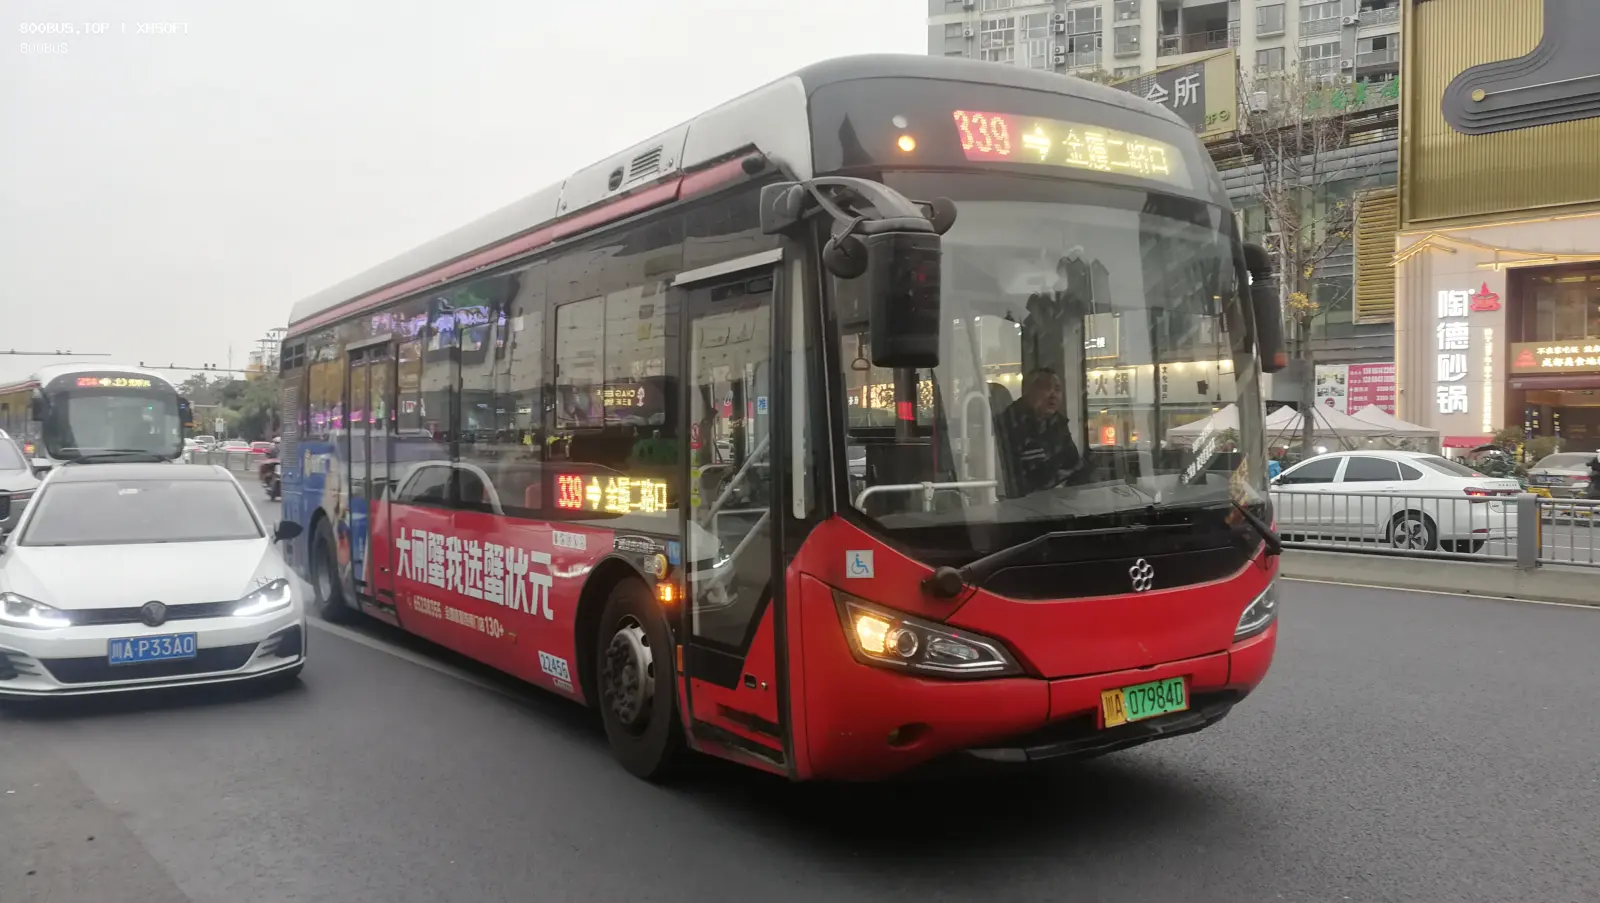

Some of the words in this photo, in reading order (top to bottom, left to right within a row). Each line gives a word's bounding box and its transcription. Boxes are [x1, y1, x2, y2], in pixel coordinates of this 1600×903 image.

[953, 109, 1011, 156] 339
[1436, 290, 1470, 415] 陶德砂锅
[558, 475, 583, 509] 339
[395, 527, 554, 621] 大闸蟹我选蟹状元
[540, 653, 569, 679] 22456
